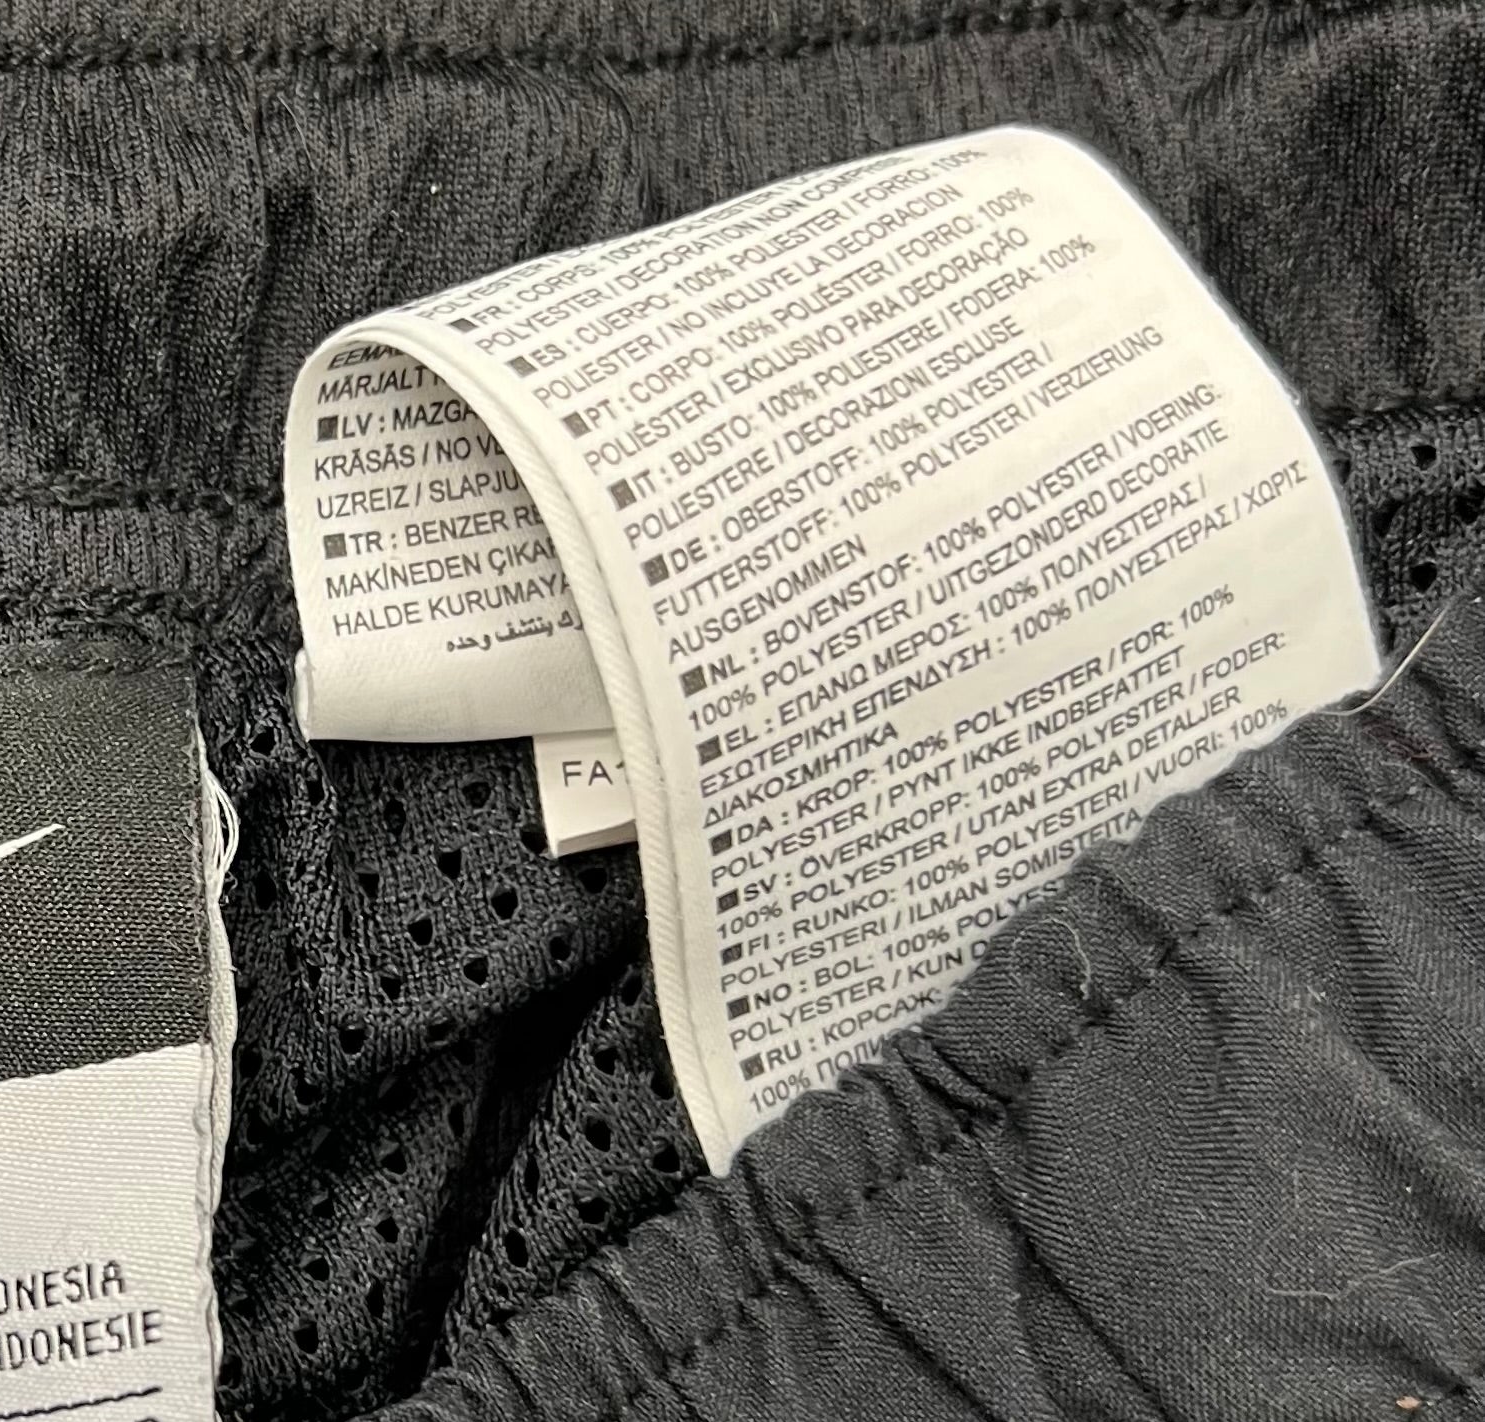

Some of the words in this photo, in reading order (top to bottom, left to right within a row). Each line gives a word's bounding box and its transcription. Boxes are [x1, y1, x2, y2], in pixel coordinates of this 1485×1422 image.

[471, 304, 510, 325] FR
[475, 287, 612, 355] POLYESTER
[756, 201, 806, 226] NON
[529, 342, 567, 368] ES
[575, 293, 680, 345] CUERPO:
[673, 263, 736, 298] 100%
[731, 207, 851, 271] POLIESTER
[853, 166, 941, 208] FORRO:
[931, 148, 990, 172] 100%
[532, 334, 661, 408] POLIESTER
[665, 310, 707, 338] NO
[700, 266, 802, 324] INCLUYE
[795, 254, 832, 277] LA
[821, 183, 965, 263] DECORACION
[583, 399, 620, 429] PT
[628, 347, 723, 404] CORPO:
[718, 316, 777, 354] 100%
[896, 213, 984, 266] FORRO:
[977, 187, 1035, 224] 100%
[721, 324, 846, 396] EXCLUSIVO
[843, 294, 906, 338] PARA
[898, 226, 1031, 308] DECORAÇÃO
[341, 413, 372, 440] LV
[624, 448, 775, 550] POLIESTERE
[784, 366, 932, 455] DECORAZIONI
[929, 315, 1024, 382] ESCLUSE
[632, 468, 656, 499] IT
[669, 412, 760, 476] BUSTO:
[757, 381, 818, 422] 100%
[815, 316, 945, 398] POLIESTERE
[946, 265, 1043, 324] FODERA:
[1038, 233, 1098, 274] 100%
[317, 486, 410, 520] UZREIZ
[436, 437, 472, 463] NO
[652, 506, 840, 625] FUTTERSTOFF:
[840, 471, 903, 520] 100%
[899, 401, 1029, 487] POLYESTER
[1031, 324, 1164, 407] VERZIERUNG
[669, 537, 708, 575] DE
[721, 444, 871, 542] OBERSTOFF:
[868, 414, 928, 459] 100%
[926, 349, 1044, 429] POLYESTER
[350, 531, 384, 555] TR
[404, 510, 507, 547] BENZER
[667, 534, 868, 664] AUSGENOMMEN
[689, 684, 757, 732] 100%
[761, 598, 912, 696] POLYESTER
[926, 493, 1108, 607] UITGEZONDERD
[1106, 420, 1230, 504] DECORATIE
[707, 654, 745, 685] NL
[764, 555, 924, 656] BOVENSTOF:
[922, 517, 986, 564] 100%
[986, 442, 1116, 532] POLYESTER
[1116, 381, 1224, 450] VOERING:
[333, 601, 422, 636] HALDE
[778, 663, 869, 726] ΕΠΑΝΩ
[975, 576, 1039, 624] 100%
[1011, 599, 1071, 645] 100%
[562, 760, 624, 786] FA
[711, 801, 868, 887] POLYESTER
[888, 758, 956, 808] PYNT
[962, 732, 1022, 776] IKKE
[1028, 645, 1185, 744] INDBEFATTET
[736, 816, 774, 844] DA
[797, 768, 878, 819] KROP:
[883, 730, 949, 775] 100%
[955, 657, 1103, 743] POLYESTER
[1121, 620, 1175, 664] FOR:
[1179, 584, 1236, 630] 100%
[743, 874, 777, 902] SV
[976, 759, 1041, 801] 100%
[1046, 680, 1186, 769] POLYESTER
[1201, 631, 1285, 687] FODER:
[716, 903, 783, 940] 100%
[790, 831, 949, 911] POLYESTER
[968, 789, 1037, 837] UTAN
[1042, 748, 1122, 803] EXTRA
[1127, 685, 1242, 763] DETALJER
[748, 933, 771, 957] FI
[792, 885, 896, 938] RUNKO:
[904, 856, 970, 896] 100%
[975, 780, 1128, 866] POLYESTERI
[1145, 728, 1222, 785] VUORI:
[1229, 699, 1288, 742] 100%
[720, 917, 887, 992] POLYESTERI
[909, 878, 989, 926] ILMAN
[729, 975, 885, 1050] POLYESTER
[906, 945, 964, 984] KUN
[754, 982, 792, 1010] NO
[814, 954, 875, 988] BOL:
[882, 926, 951, 964] 100%
[747, 1071, 811, 1113] 100%
